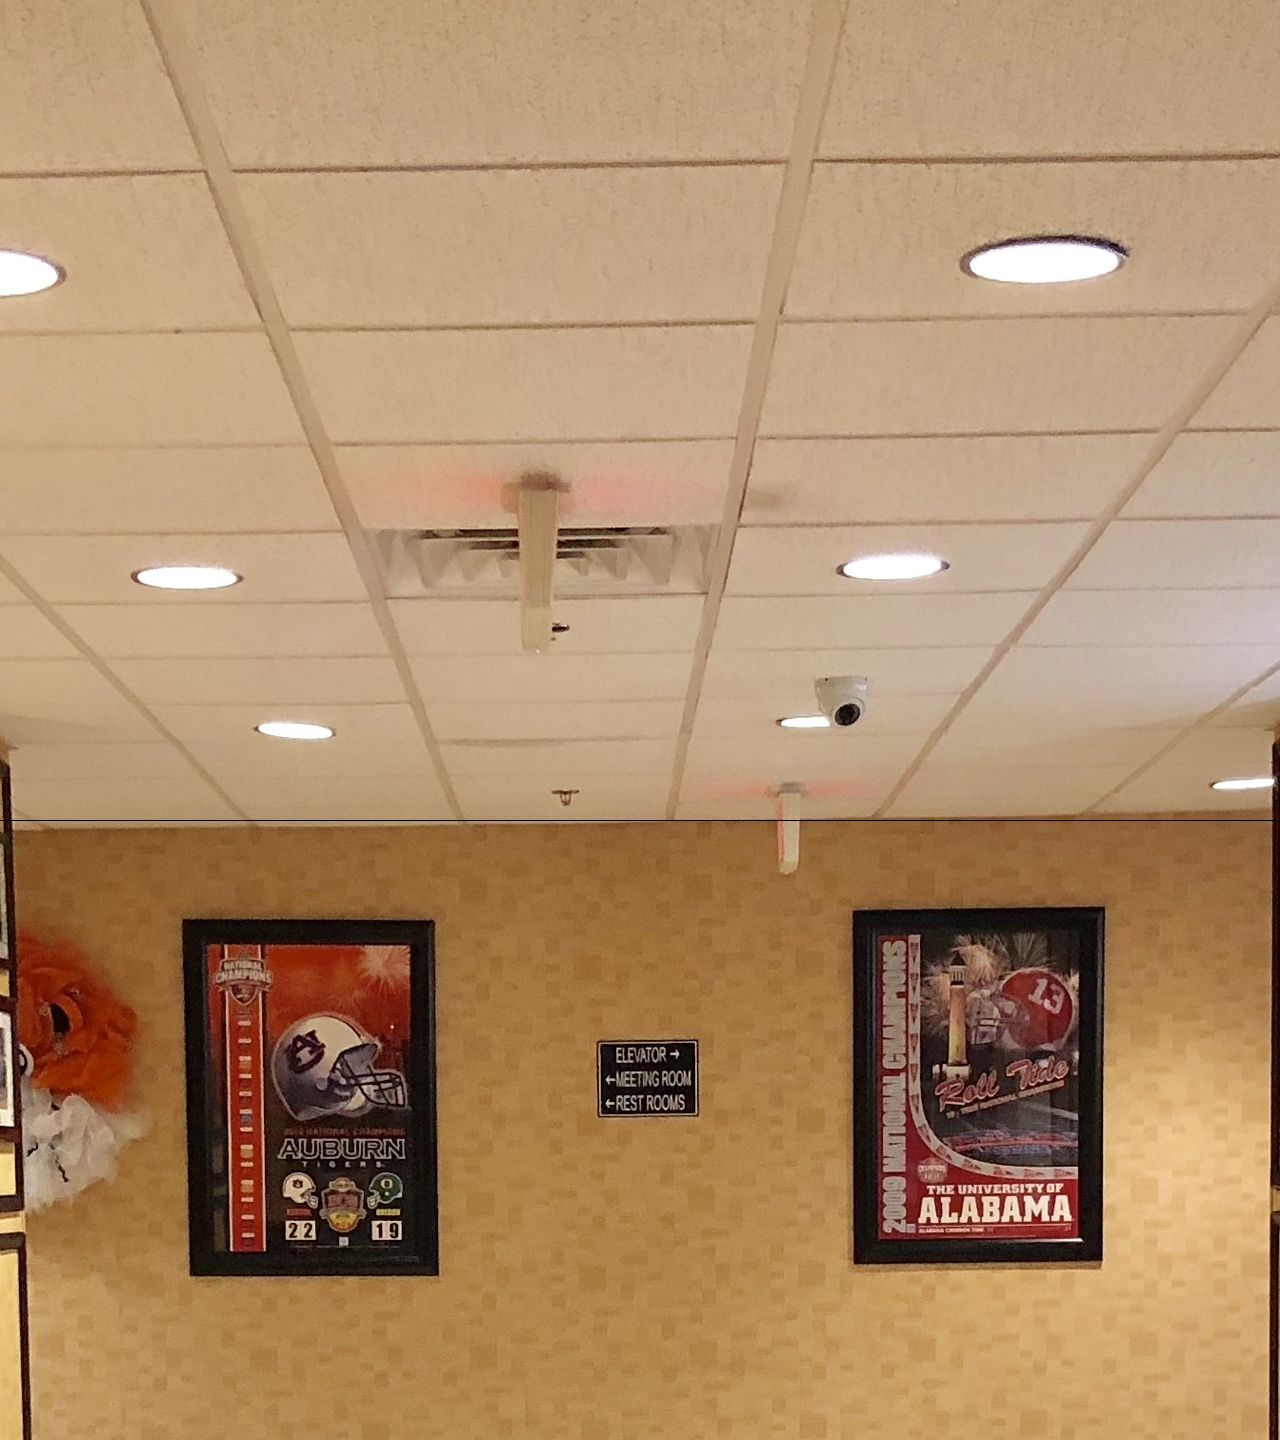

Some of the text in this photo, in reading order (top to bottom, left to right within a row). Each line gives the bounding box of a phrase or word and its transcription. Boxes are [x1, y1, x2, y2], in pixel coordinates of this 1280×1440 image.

[615, 1046, 667, 1064] ELEVATOR
[615, 1070, 692, 1088] MEETING ROOM
[935, 1069, 1000, 1112] Roll
[1006, 1055, 1069, 1090] Tide
[615, 1094, 686, 1111] REST ROOMS
[882, 1071, 907, 1173] NATIONAL
[277, 1138, 406, 1160] AUBURN
[926, 1183, 1064, 1195] THE UNIVERSITY OF
[882, 1176, 907, 1234] 2009
[918, 1195, 1072, 1224] ALABAMA
[288, 1222, 313, 1239] 22
[376, 1222, 399, 1239] 19
